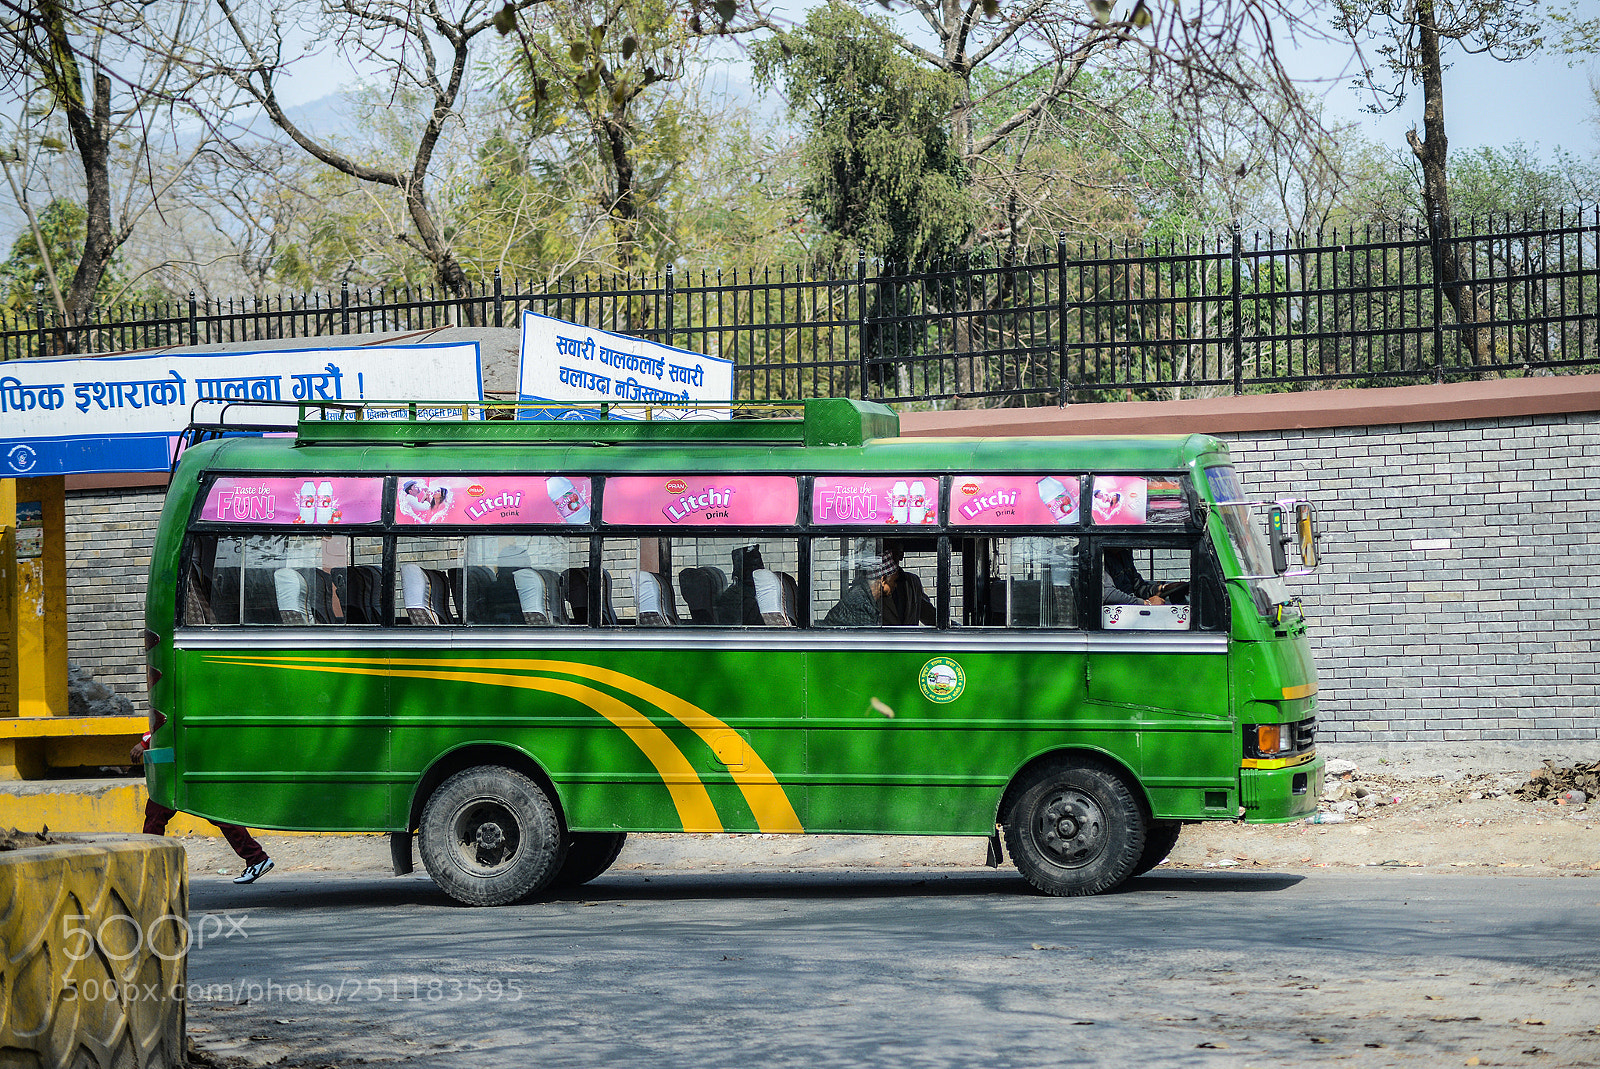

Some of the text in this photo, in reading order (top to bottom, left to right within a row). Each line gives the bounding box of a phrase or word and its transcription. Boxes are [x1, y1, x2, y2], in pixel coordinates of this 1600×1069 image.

[556, 335, 704, 387] सवारी चालकलाई सवारी
[73, 369, 187, 414] इशाराको
[195, 375, 282, 405] पालना
[559, 366, 611, 394] चलाउदा
[234, 482, 271, 495] Taste the
[835, 481, 872, 494] Taste the
[217, 491, 276, 520] FUN!
[469, 492, 522, 518] Litchi
[500, 510, 520, 518] Drink
[668, 488, 731, 520] Litchi
[705, 510, 729, 520] Drink
[819, 491, 877, 520] FUN!
[963, 491, 1017, 518] Litchi
[995, 509, 1015, 518] Drink
